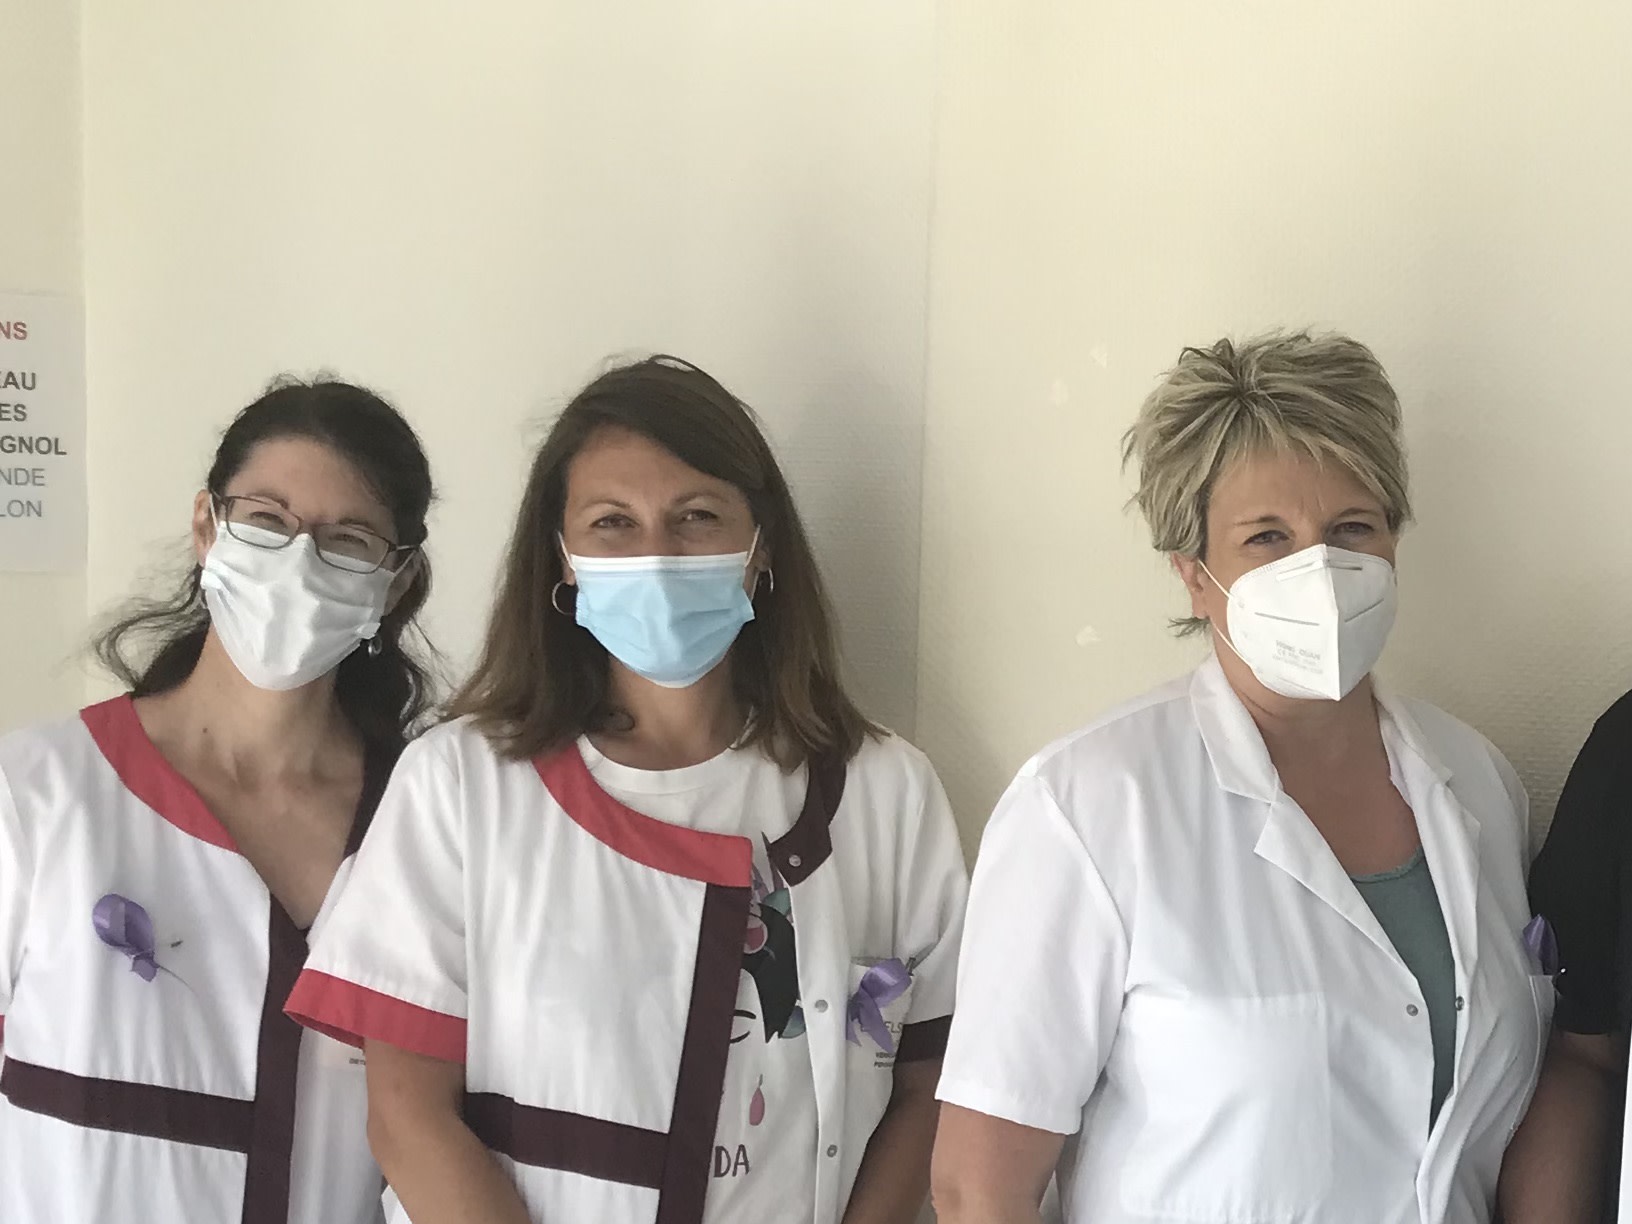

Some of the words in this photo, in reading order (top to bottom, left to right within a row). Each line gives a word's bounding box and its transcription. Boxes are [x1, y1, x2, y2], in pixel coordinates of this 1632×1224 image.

[0, 371, 36, 391] AU
[0, 435, 67, 456] GNOL
[713, 1144, 750, 1178] DA
